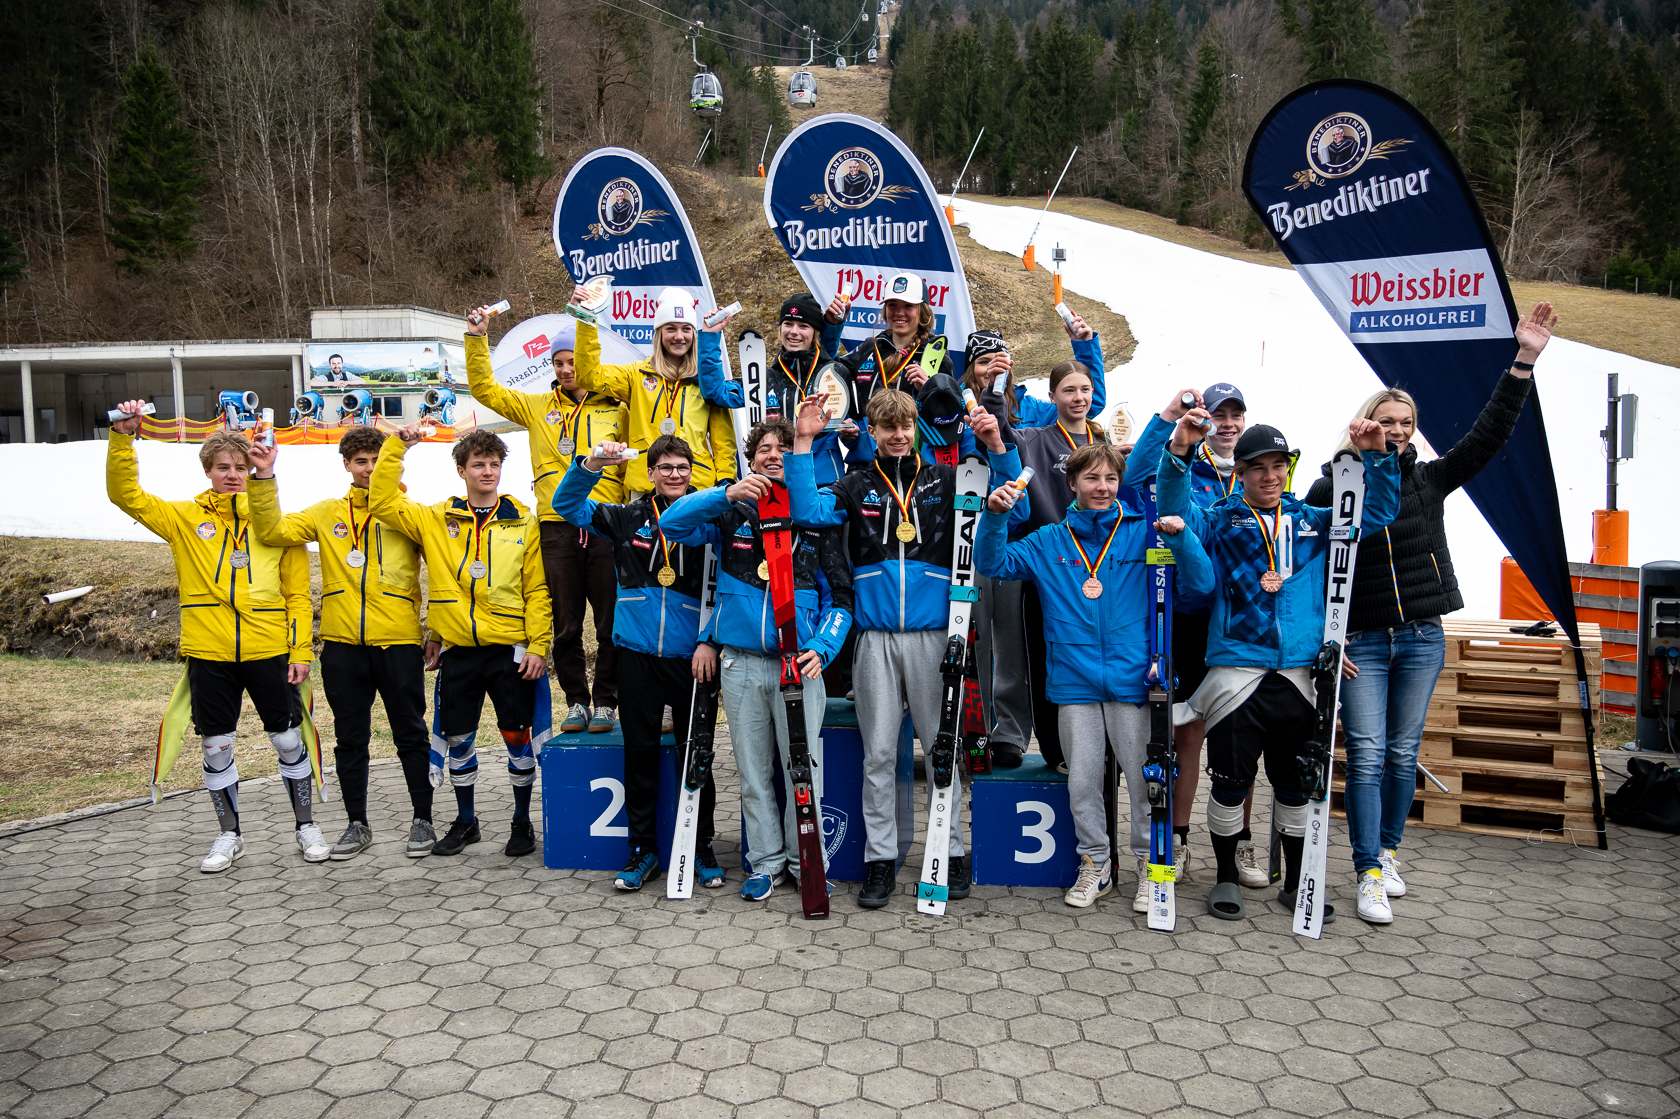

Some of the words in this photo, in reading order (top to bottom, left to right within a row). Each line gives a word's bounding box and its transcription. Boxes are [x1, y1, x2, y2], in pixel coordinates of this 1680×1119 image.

[1311, 117, 1366, 154] BENEDIKTINER
[828, 150, 879, 180] BENEDIKTINER
[601, 181, 639, 210] BENEDIKTINER
[1267, 167, 1431, 241] Benediktiner
[783, 215, 929, 259] Benediktiner
[569, 238, 680, 284] Benediktiner
[1350, 268, 1484, 307] Weissbier
[1358, 310, 1475, 329] ALKOHOLFREI
[747, 362, 761, 428] EAD
[298, 781, 310, 806] SOCKS
[590, 777, 629, 837] 2
[827, 821, 846, 858] TENKIRCHEN
[1014, 801, 1056, 864] 3
[677, 855, 686, 892] HEAD
[1303, 878, 1315, 930] HEAD
